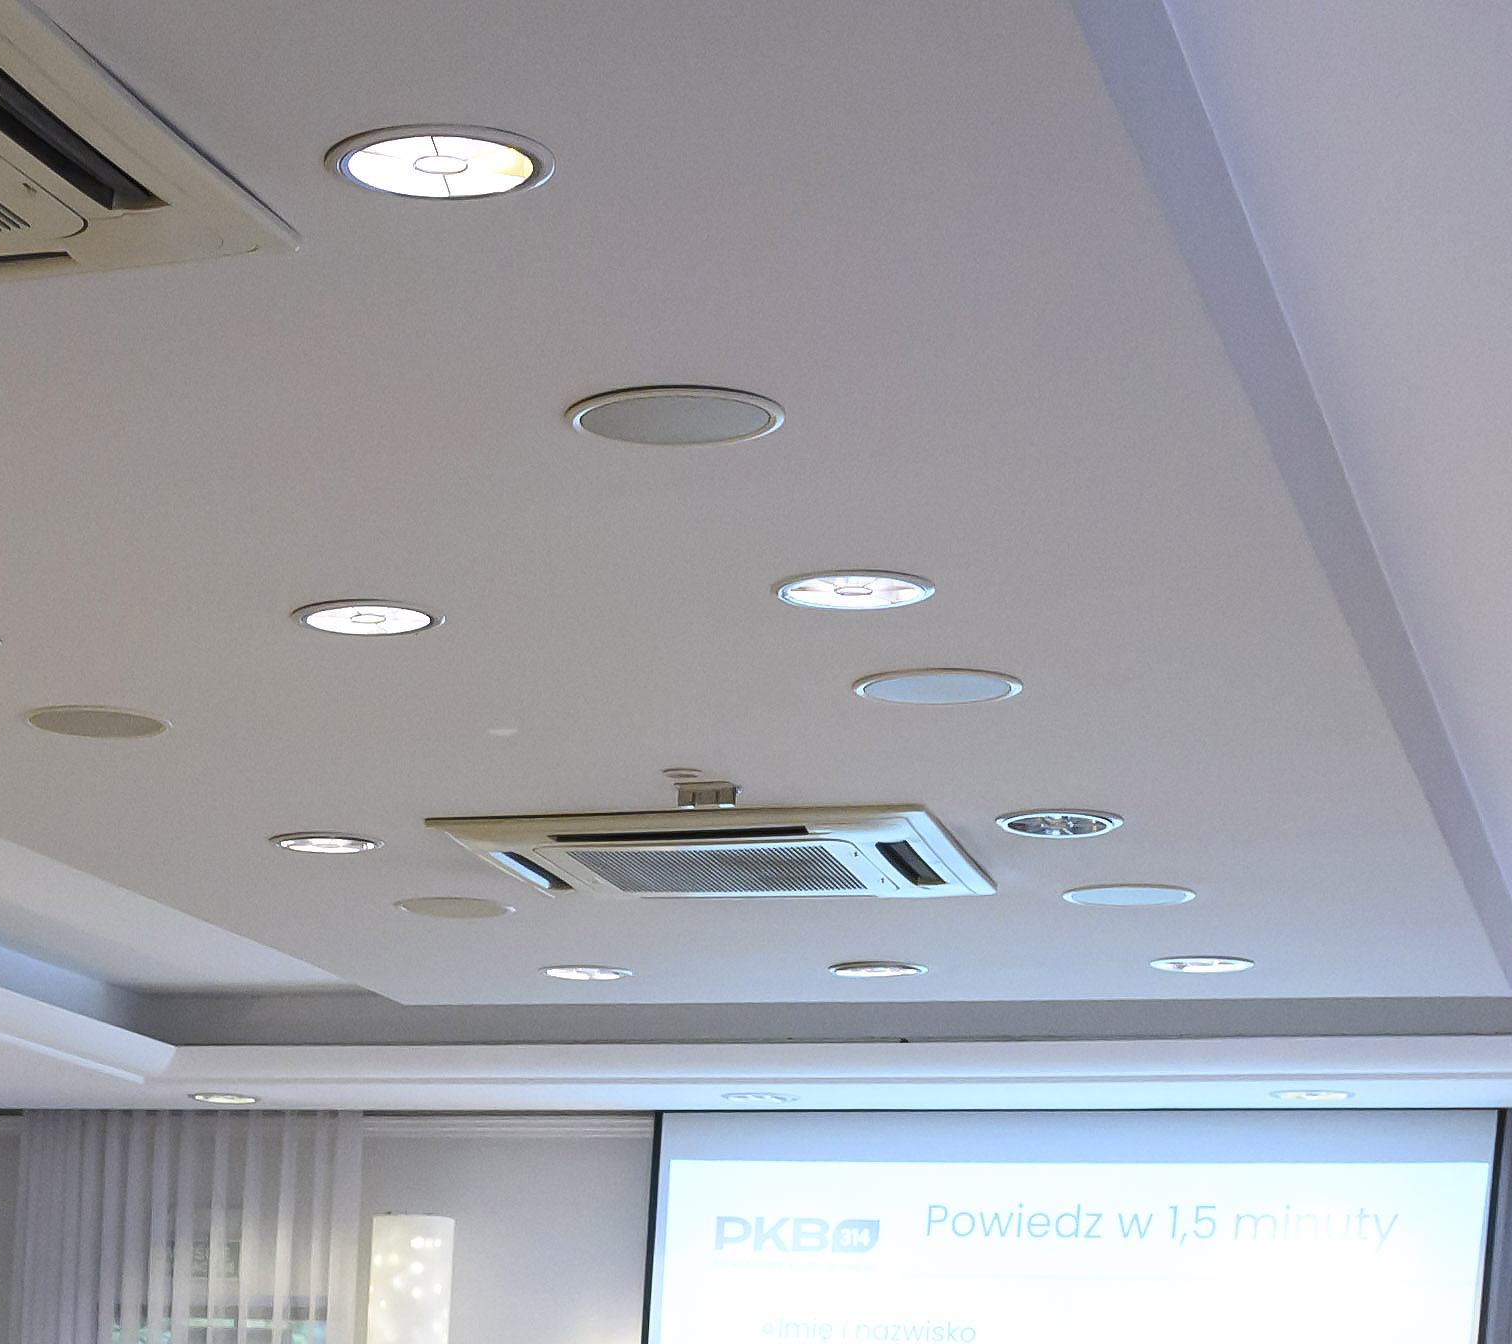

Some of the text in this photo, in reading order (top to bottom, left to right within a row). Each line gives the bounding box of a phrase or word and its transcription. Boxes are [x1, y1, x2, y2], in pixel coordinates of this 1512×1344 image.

[925, 1202, 1104, 1239] Powiedz
[1117, 1212, 1154, 1239] w
[1167, 1204, 1217, 1247] 1,5
[1233, 1204, 1399, 1252] minuty
[777, 1317, 833, 1344] Imię
[855, 1319, 977, 1344] nazwisko
